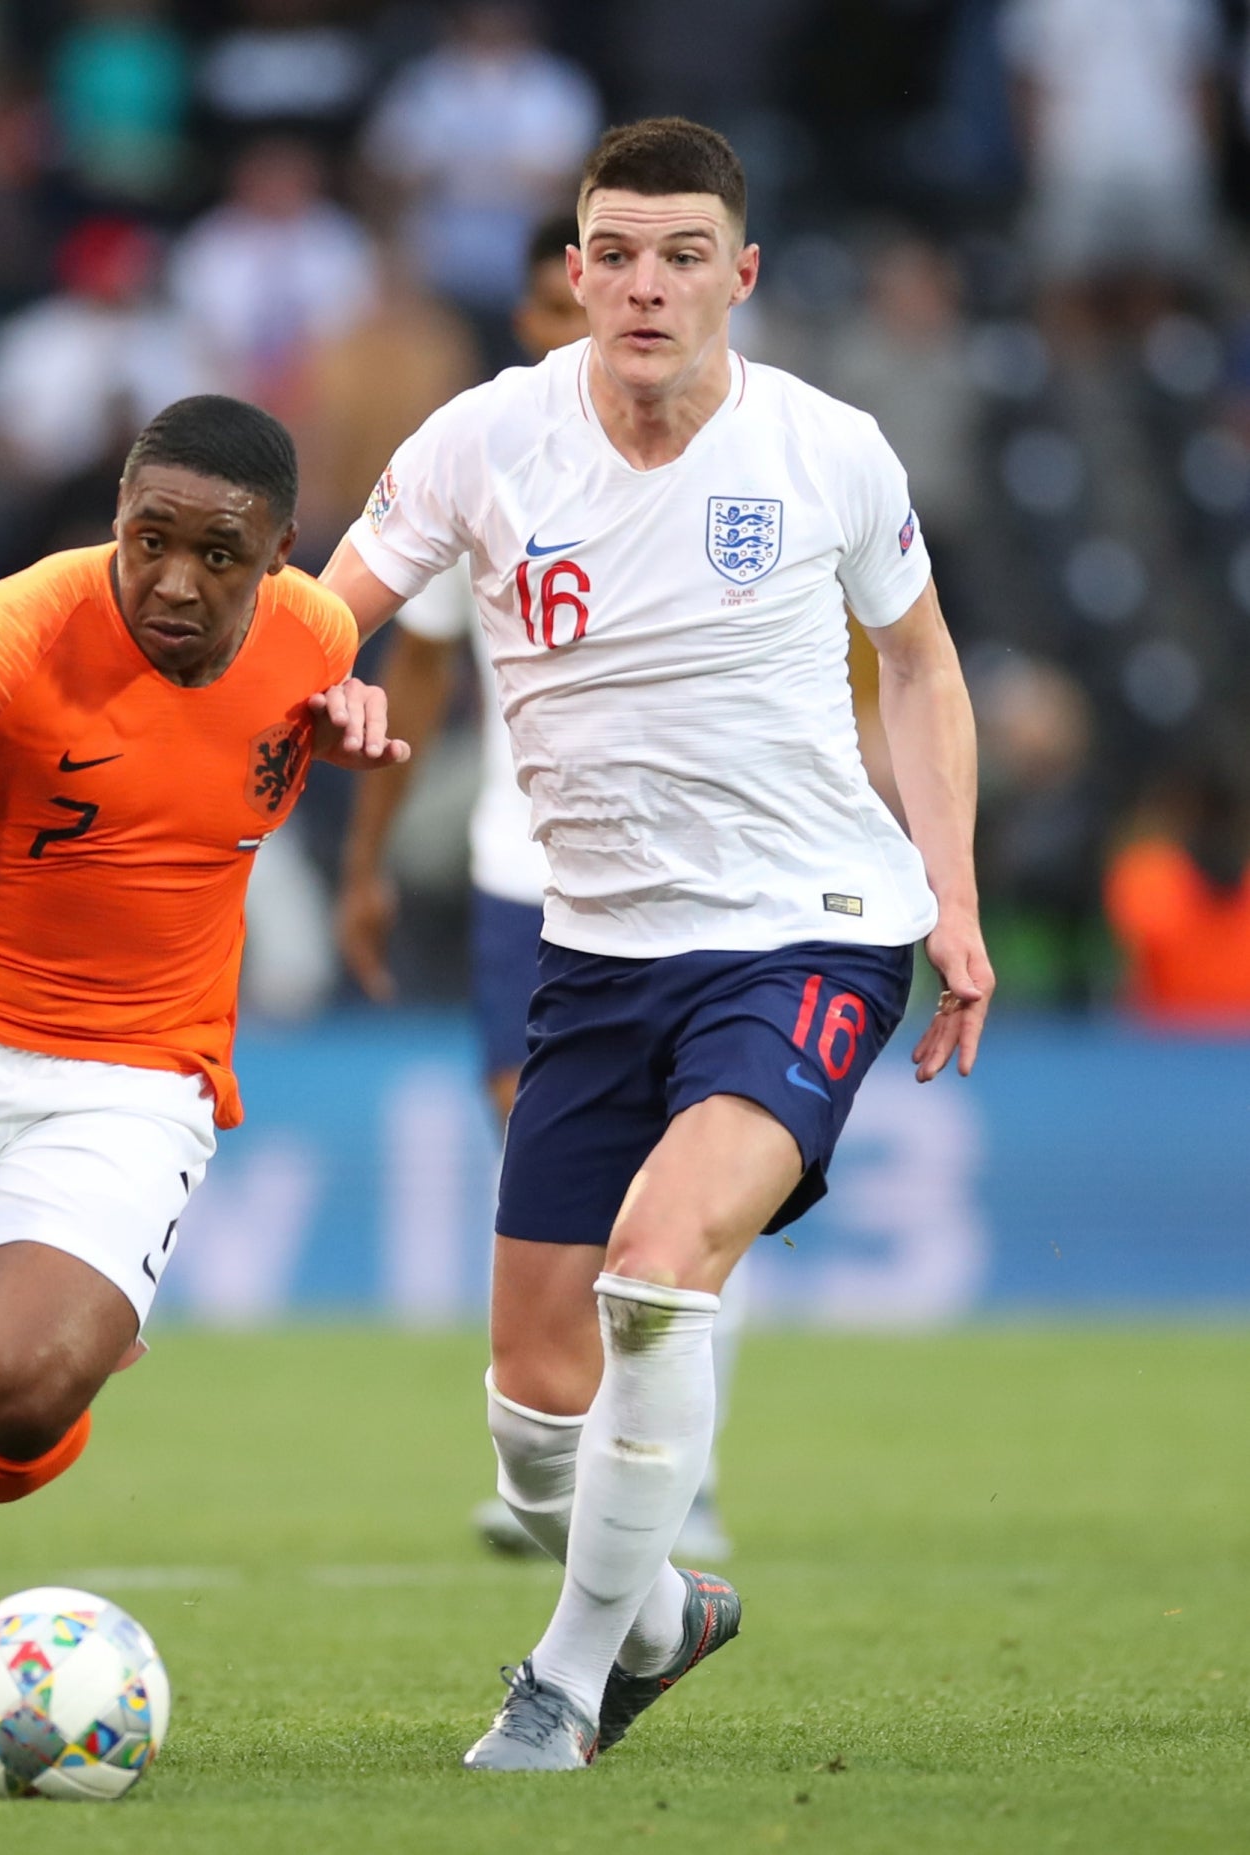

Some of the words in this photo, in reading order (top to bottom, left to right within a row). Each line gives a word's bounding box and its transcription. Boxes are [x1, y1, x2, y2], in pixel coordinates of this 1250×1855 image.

[516, 559, 591, 650] 16
[29, 796, 99, 859] 7
[791, 973, 866, 1081] 16
